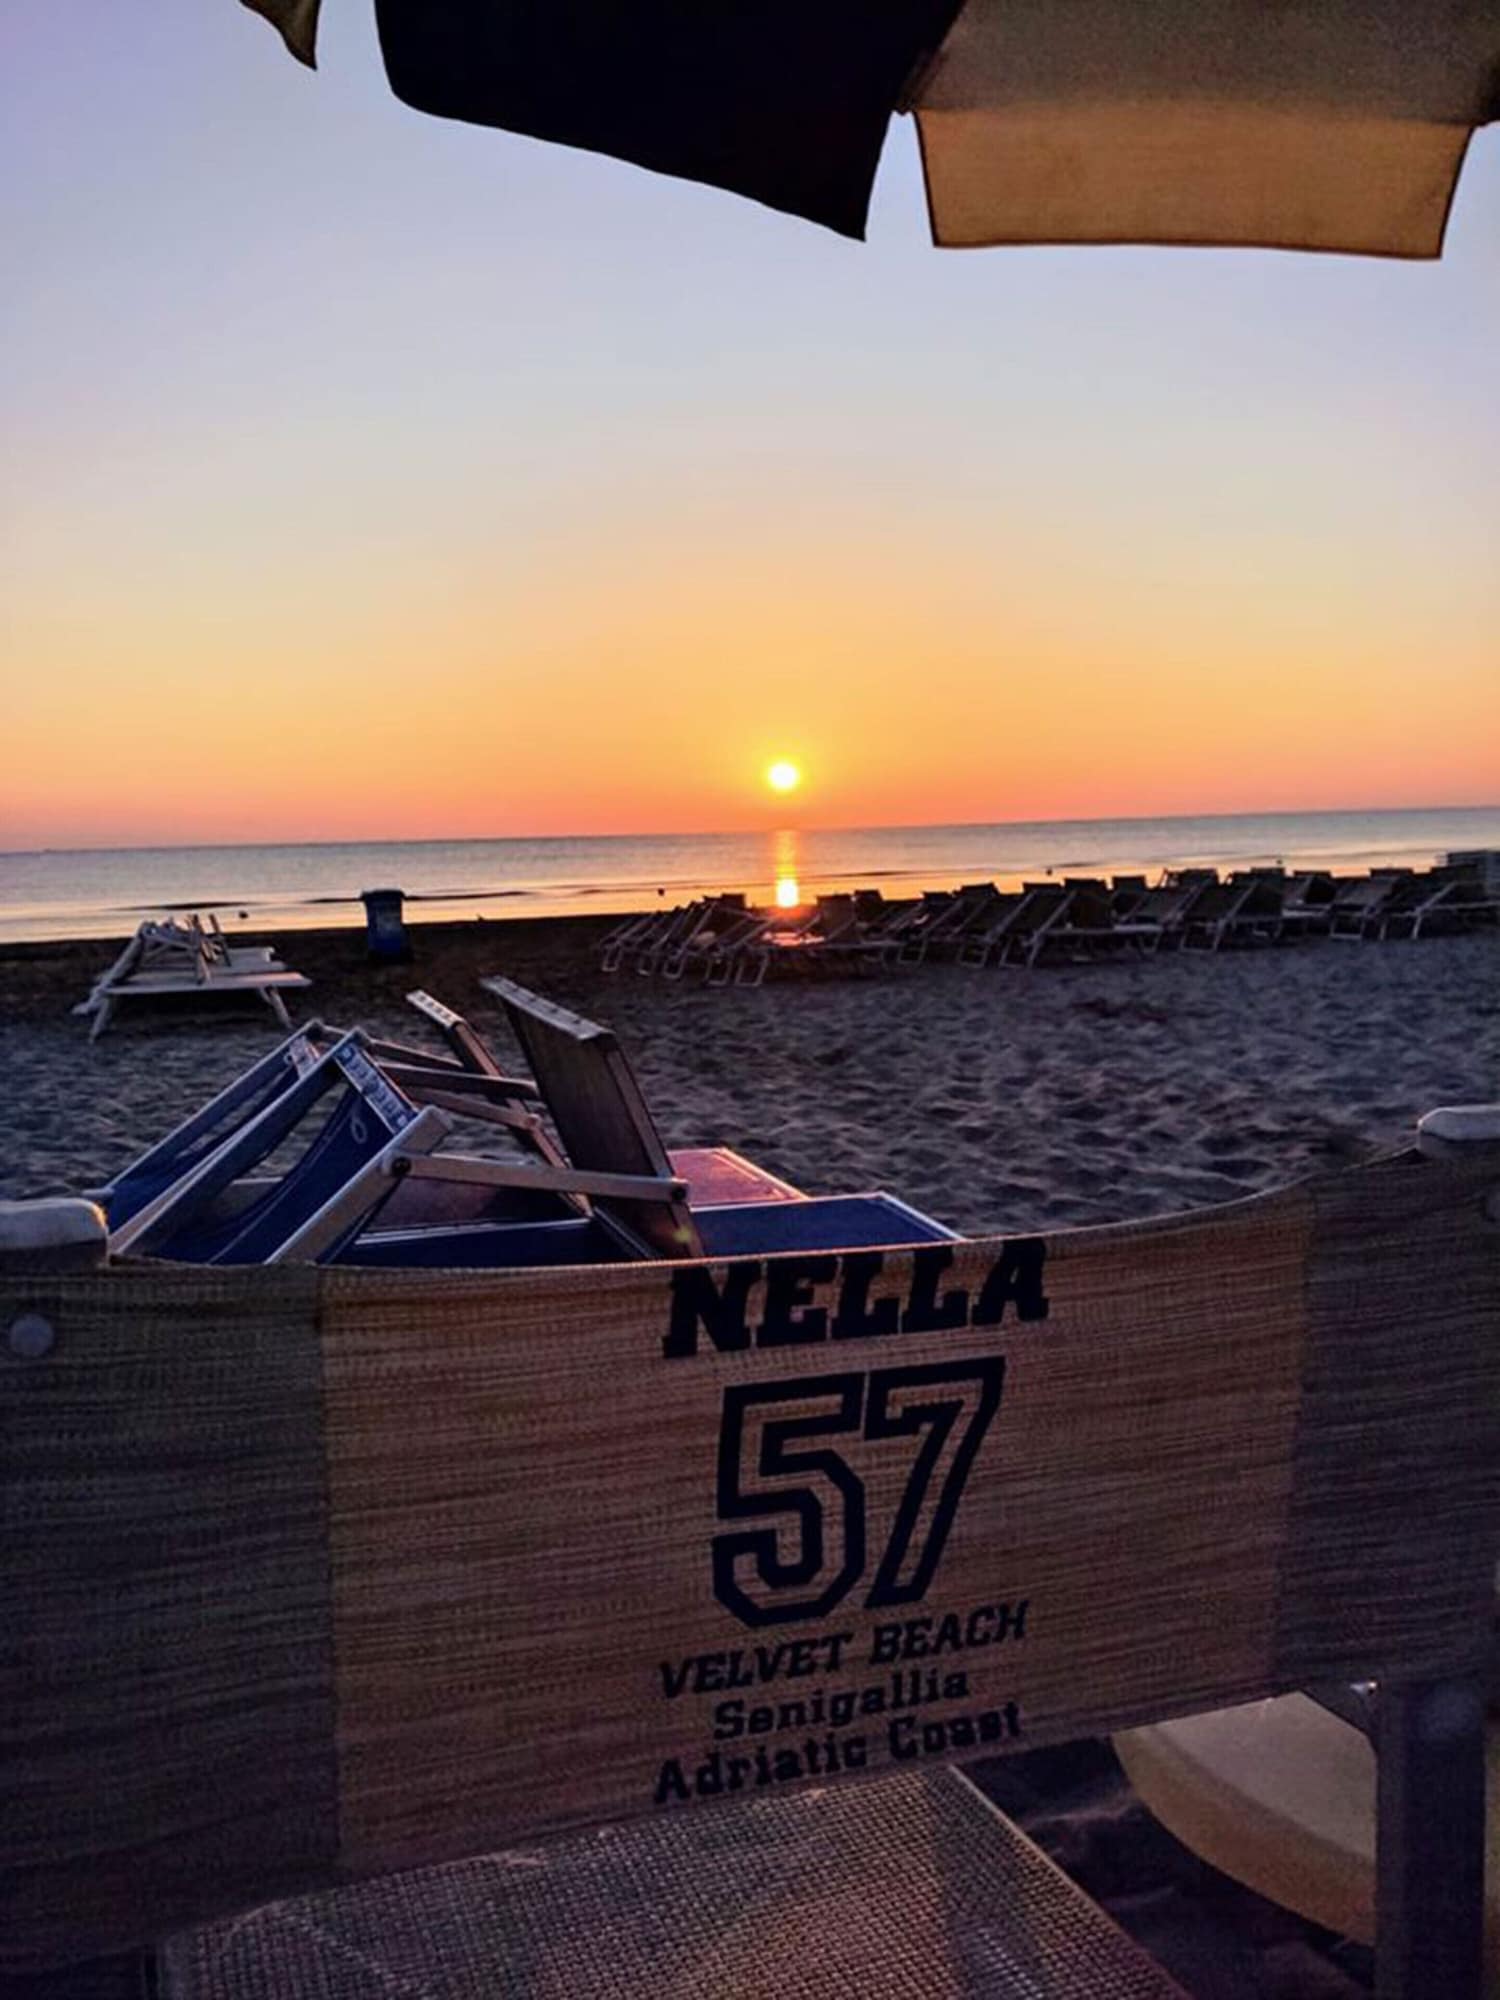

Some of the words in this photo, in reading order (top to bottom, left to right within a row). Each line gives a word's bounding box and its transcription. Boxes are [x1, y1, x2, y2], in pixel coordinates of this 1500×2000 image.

[662, 1237, 1049, 1358] NELLA
[711, 1355, 1006, 1628] 57
[659, 1633, 853, 1699] VELVET
[869, 1601, 1029, 1665] BEACH
[654, 1733, 866, 1804] Adriatic
[888, 1702, 1021, 1760] Coast
[714, 1669, 970, 1740] Senigallia
